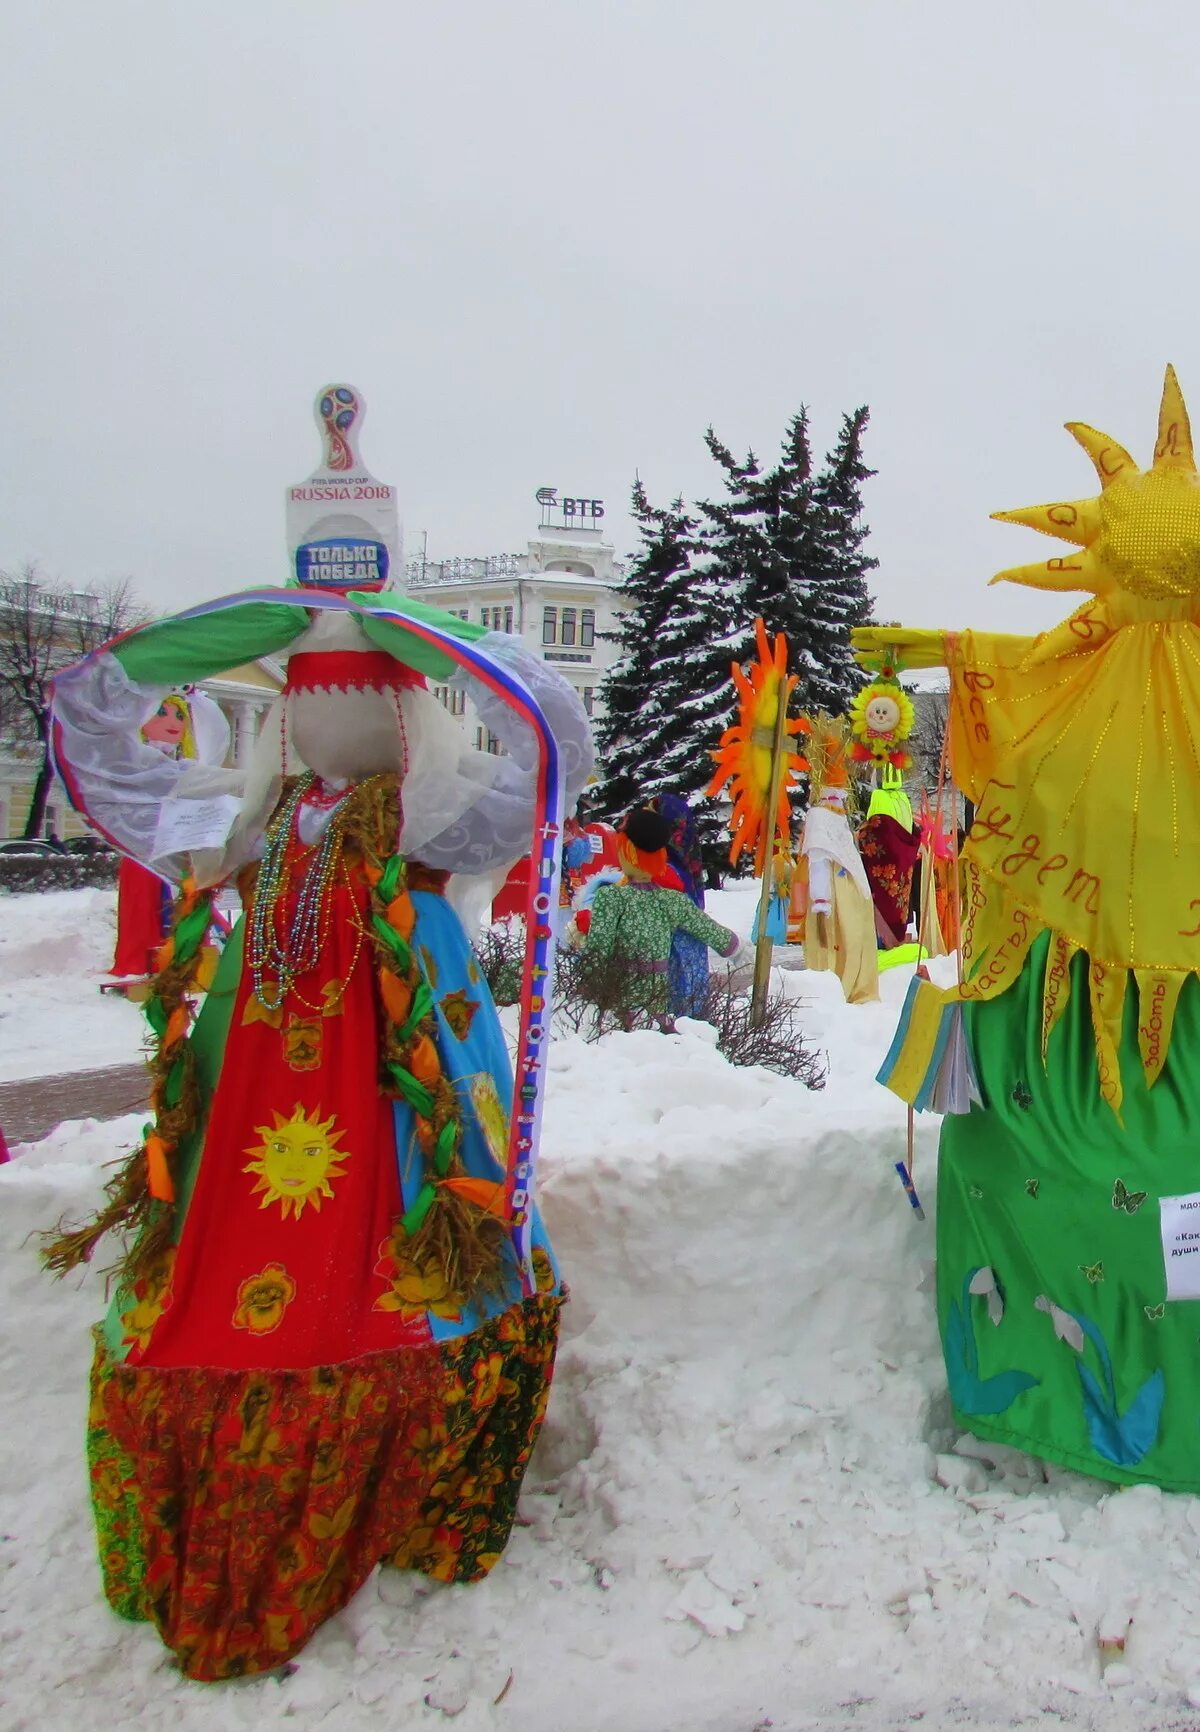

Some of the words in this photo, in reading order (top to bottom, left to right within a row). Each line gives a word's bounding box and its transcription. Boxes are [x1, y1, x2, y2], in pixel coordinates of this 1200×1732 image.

[291, 487, 351, 501] RUSSIA
[354, 486, 391, 500] 2018
[563, 498, 605, 518] ВТБ
[308, 545, 378, 563] ТОЛЬКО
[308, 563, 380, 580] ПОБЕДА
[1175, 1231, 1200, 1242] «Как
[1171, 1246, 1199, 1257] души
